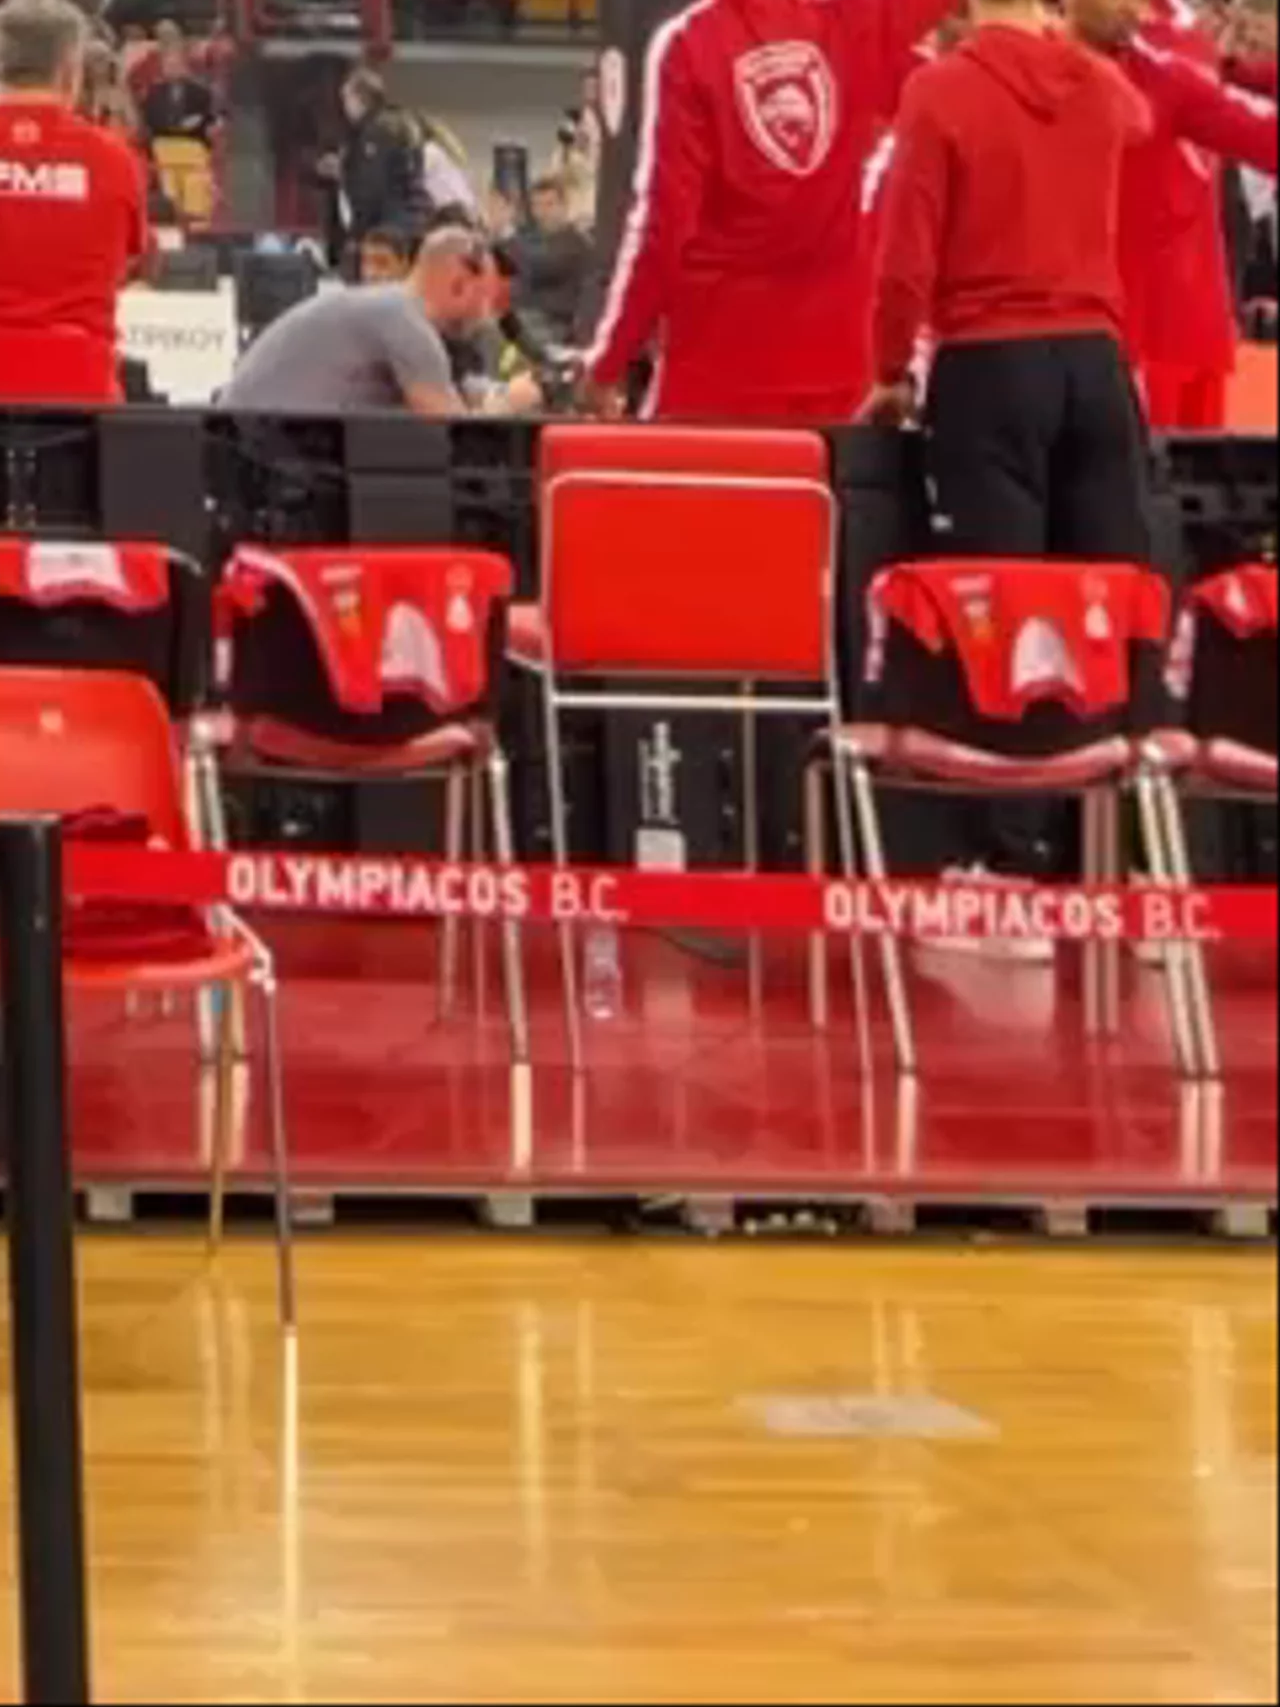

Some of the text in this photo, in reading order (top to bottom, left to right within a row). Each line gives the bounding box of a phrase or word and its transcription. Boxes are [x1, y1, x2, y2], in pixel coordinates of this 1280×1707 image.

[225, 854, 628, 923] OLYMPIACOS B.C.
[823, 885, 1224, 943] OLYMPIACOS B.C.
